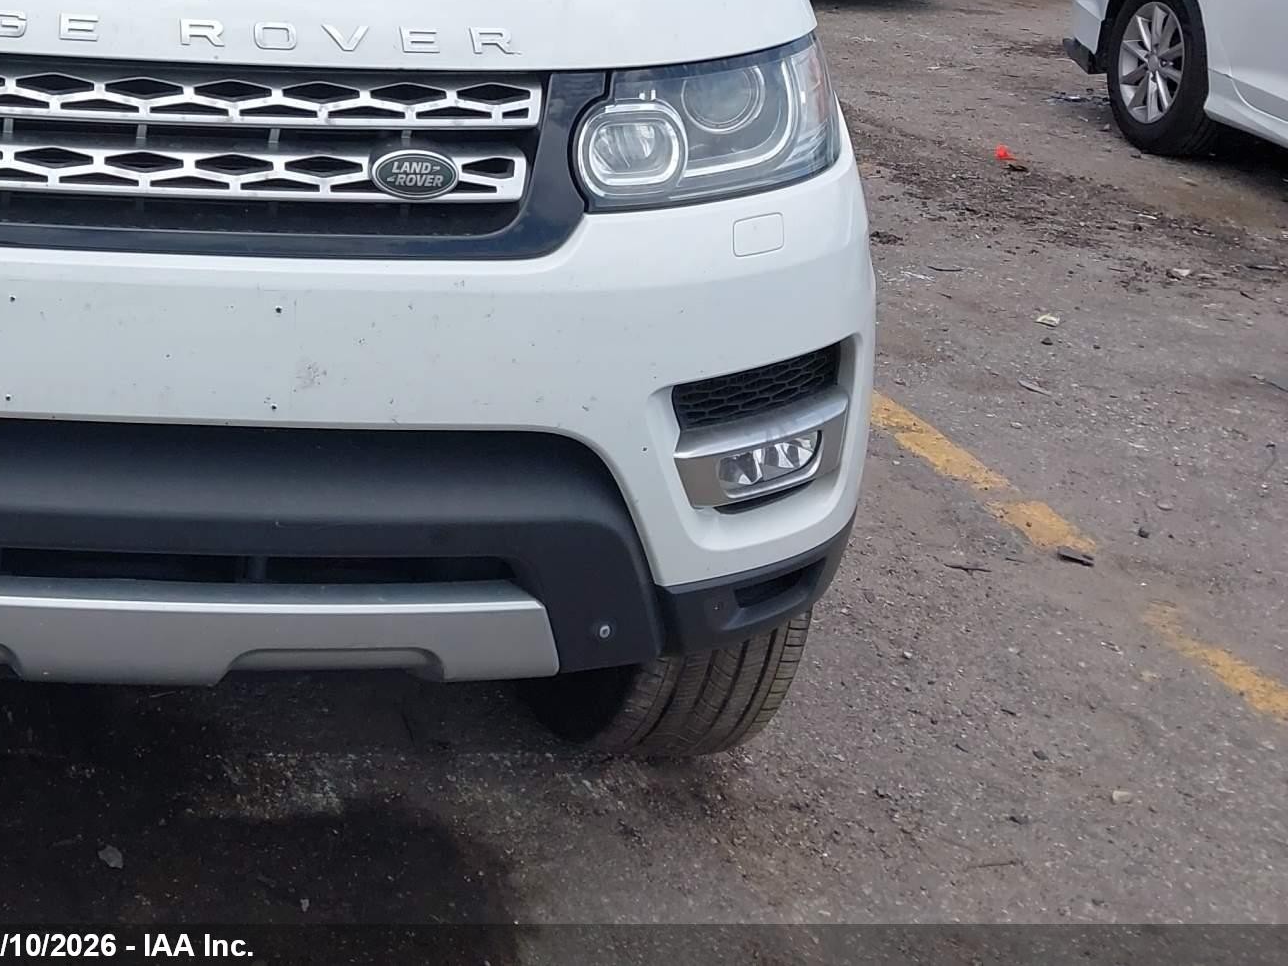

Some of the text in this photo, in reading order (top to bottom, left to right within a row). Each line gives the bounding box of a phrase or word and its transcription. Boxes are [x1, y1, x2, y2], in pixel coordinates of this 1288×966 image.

[178, 17, 523, 55] ROVER
[391, 161, 432, 174] LAND
[395, 174, 444, 187] ROVER
